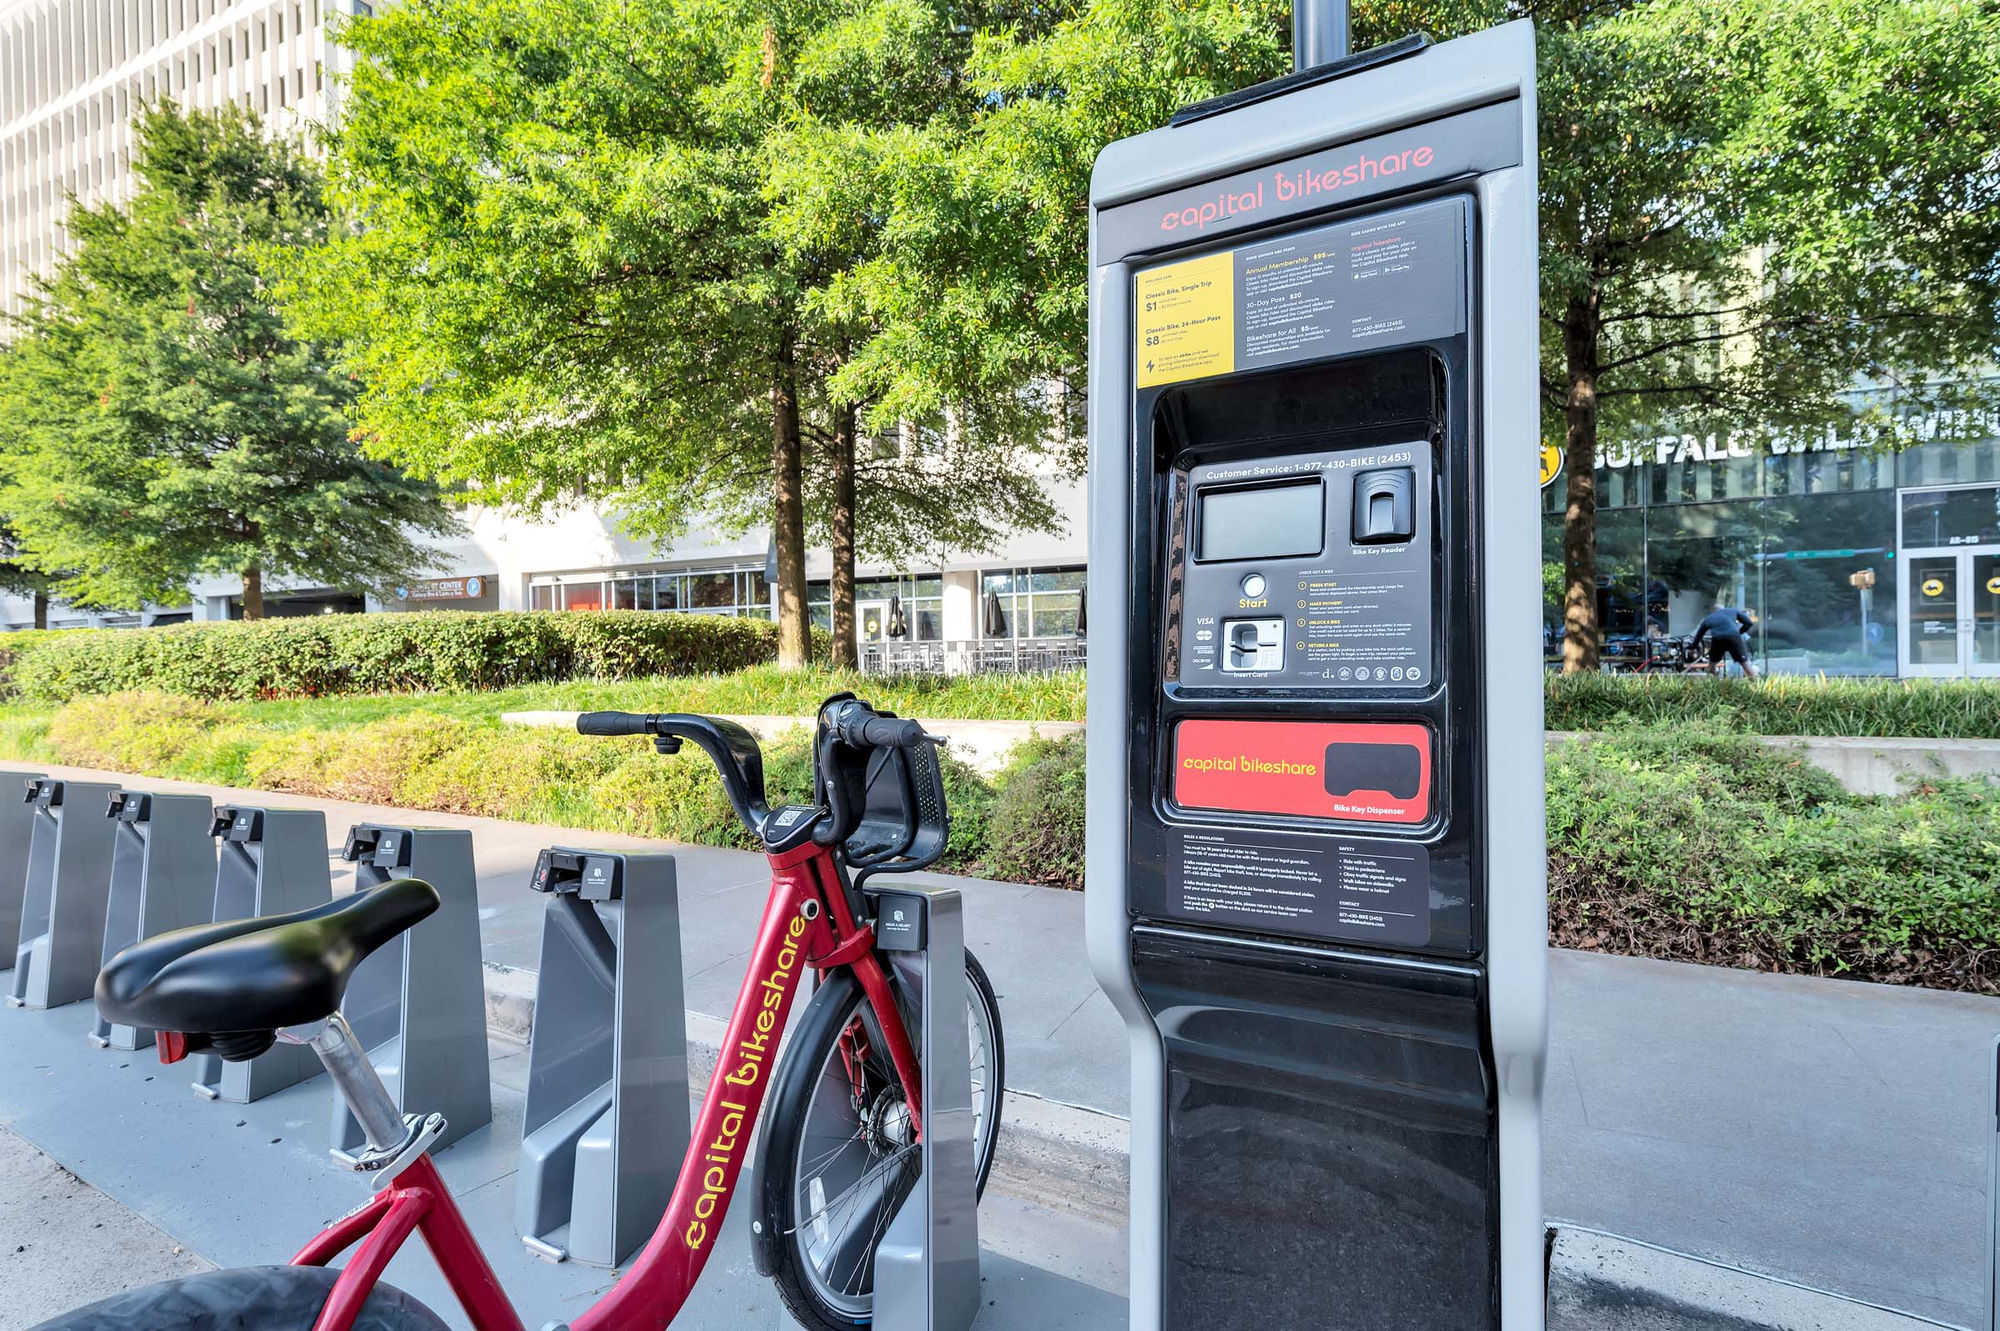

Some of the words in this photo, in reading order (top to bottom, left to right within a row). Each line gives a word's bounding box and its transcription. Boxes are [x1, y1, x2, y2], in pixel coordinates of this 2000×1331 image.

[1160, 182, 1263, 231] capital
[1274, 146, 1434, 201] bikeshare
[1246, 265, 1267, 275] Annual
[1269, 257, 1309, 269] Membership
[1146, 290, 1165, 299] Classic
[1182, 284, 1199, 292] Single
[1146, 301, 1157, 312] $1
[1146, 325, 1165, 334] Classic
[1182, 318, 1206, 327] 24-Hour
[1146, 336, 1159, 347] $8
[1247, 333, 1276, 342] Bikeshare
[1207, 468, 1252, 480] Customer
[1254, 465, 1293, 476] Service:
[1294, 456, 1374, 472] 1-877-430-BIKE
[1377, 451, 1411, 466] (2453)
[1367, 548, 1380, 556] Key
[1240, 599, 1267, 608] Start
[1183, 756, 1236, 773] capital
[1241, 755, 1316, 776] bikeshare
[1334, 804, 1350, 813] Bike
[1351, 805, 1365, 815] Key
[1366, 806, 1405, 816] Dispenser
[686, 1101, 746, 1249] capital
[725, 914, 805, 1086] bikeshare
